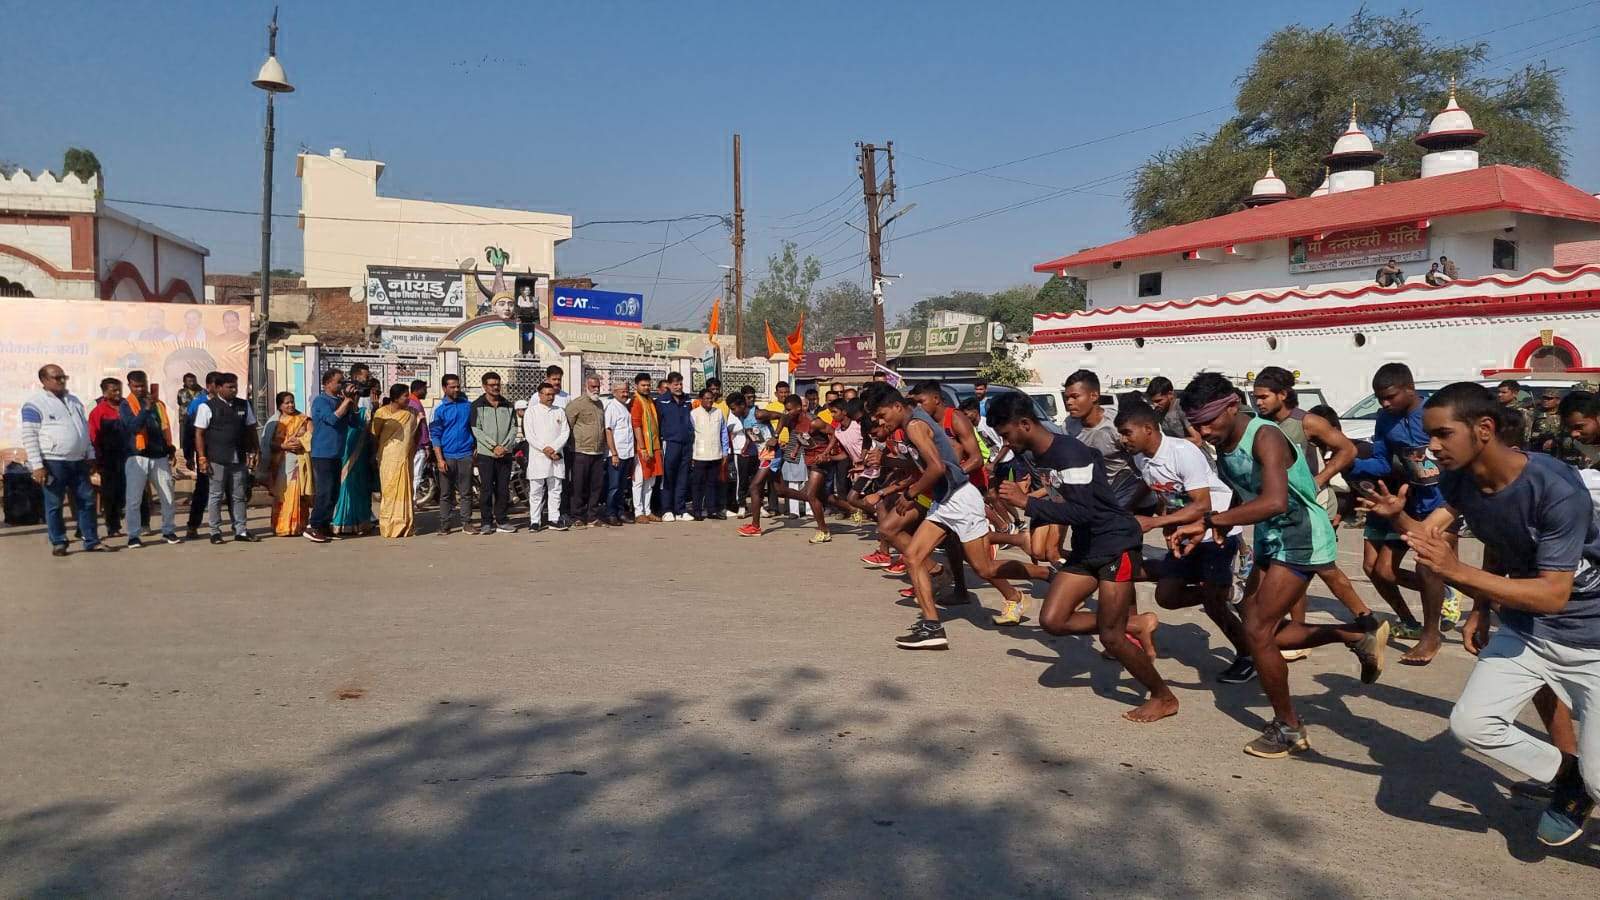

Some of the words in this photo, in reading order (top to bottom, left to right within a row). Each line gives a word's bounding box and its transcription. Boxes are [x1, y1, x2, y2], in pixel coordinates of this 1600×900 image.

[556, 296, 589, 309] CEAT
[929, 330, 955, 344] BKT
[818, 352, 847, 371] apollo
